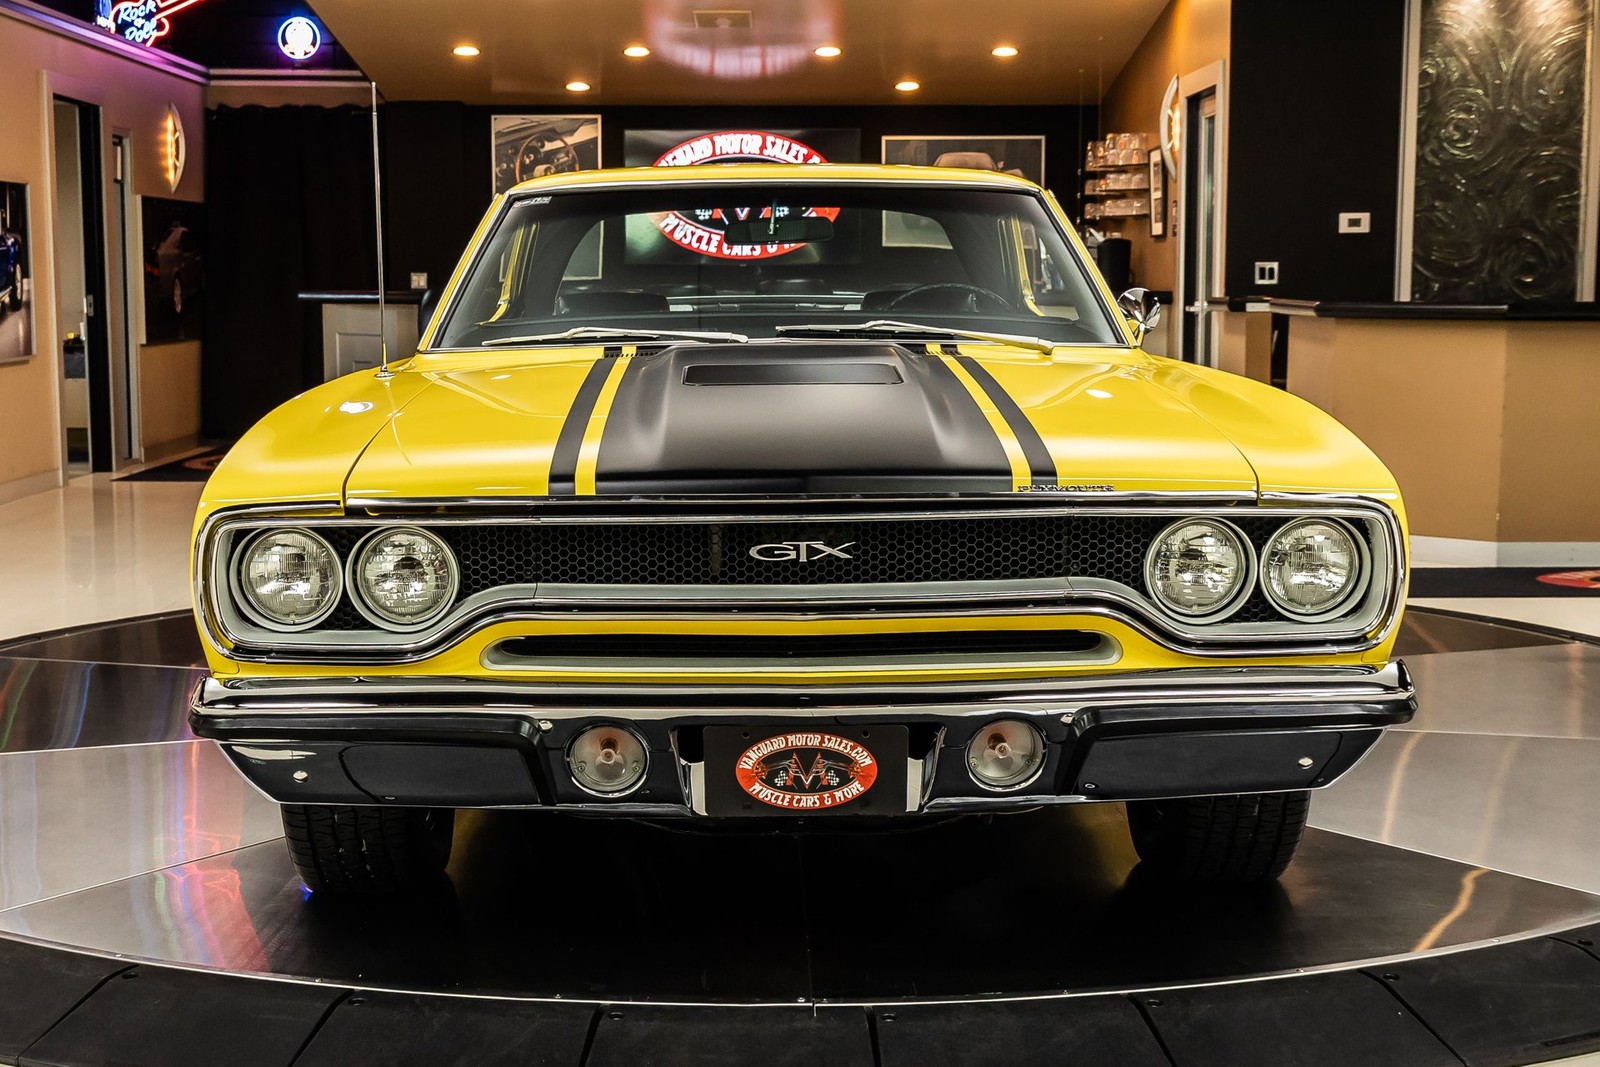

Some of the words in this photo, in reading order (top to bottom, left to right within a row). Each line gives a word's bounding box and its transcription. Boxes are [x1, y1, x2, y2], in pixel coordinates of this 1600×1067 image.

[117, 0, 157, 24] Rock
[657, 137, 713, 167] GUARD
[714, 133, 763, 156] MOTOR
[658, 212, 722, 254] MUSCLE
[1017, 484, 1115, 492] PLYMOUTH
[748, 541, 856, 562] GTX
[739, 738, 786, 770] VANGUARD
[786, 734, 821, 747] MOTOR
[822, 735, 873, 767] SALES.COM
[748, 782, 792, 806] MUSCLE
[792, 795, 820, 807] CARS
[823, 793, 832, 805] &
[833, 780, 865, 803] MORE
